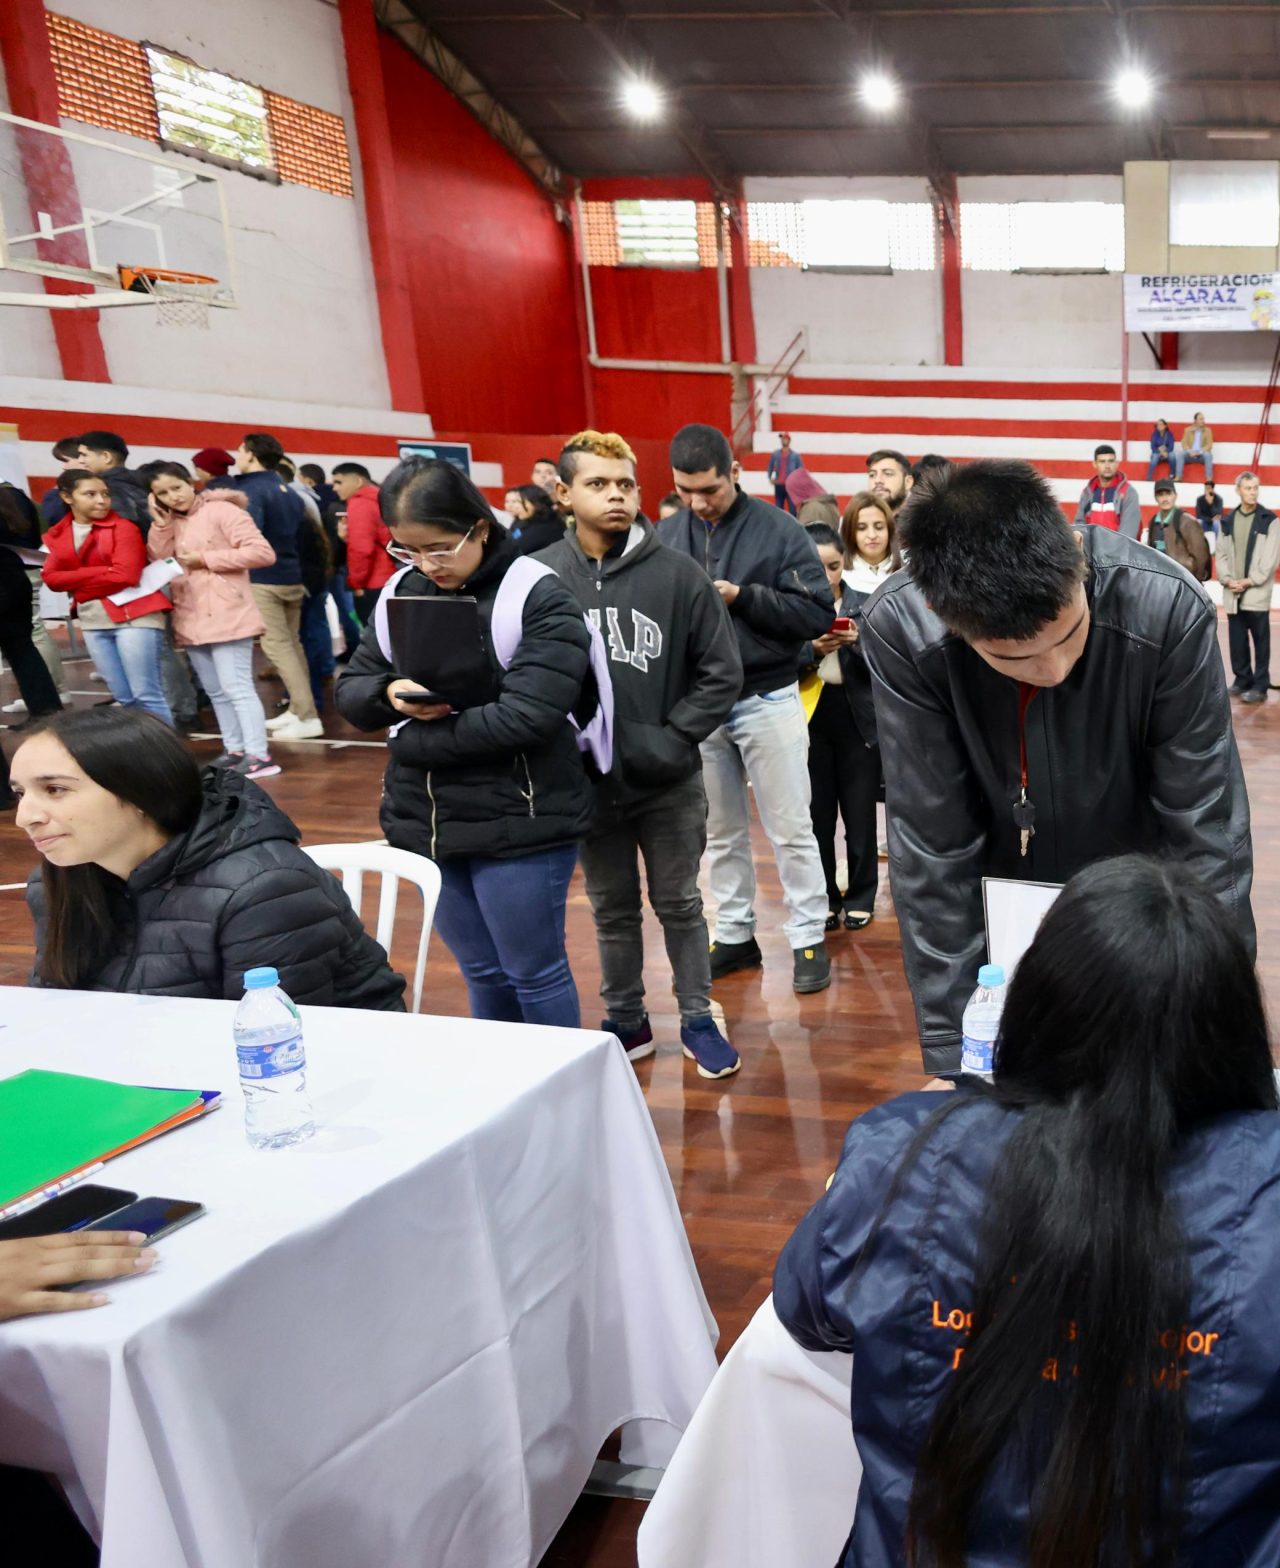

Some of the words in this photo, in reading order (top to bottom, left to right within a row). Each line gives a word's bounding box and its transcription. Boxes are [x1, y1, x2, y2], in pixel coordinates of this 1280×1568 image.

[1141, 273, 1273, 288] REFRIGERACION
[1149, 288, 1238, 304] ALCARAZ
[587, 607, 663, 674] AP
